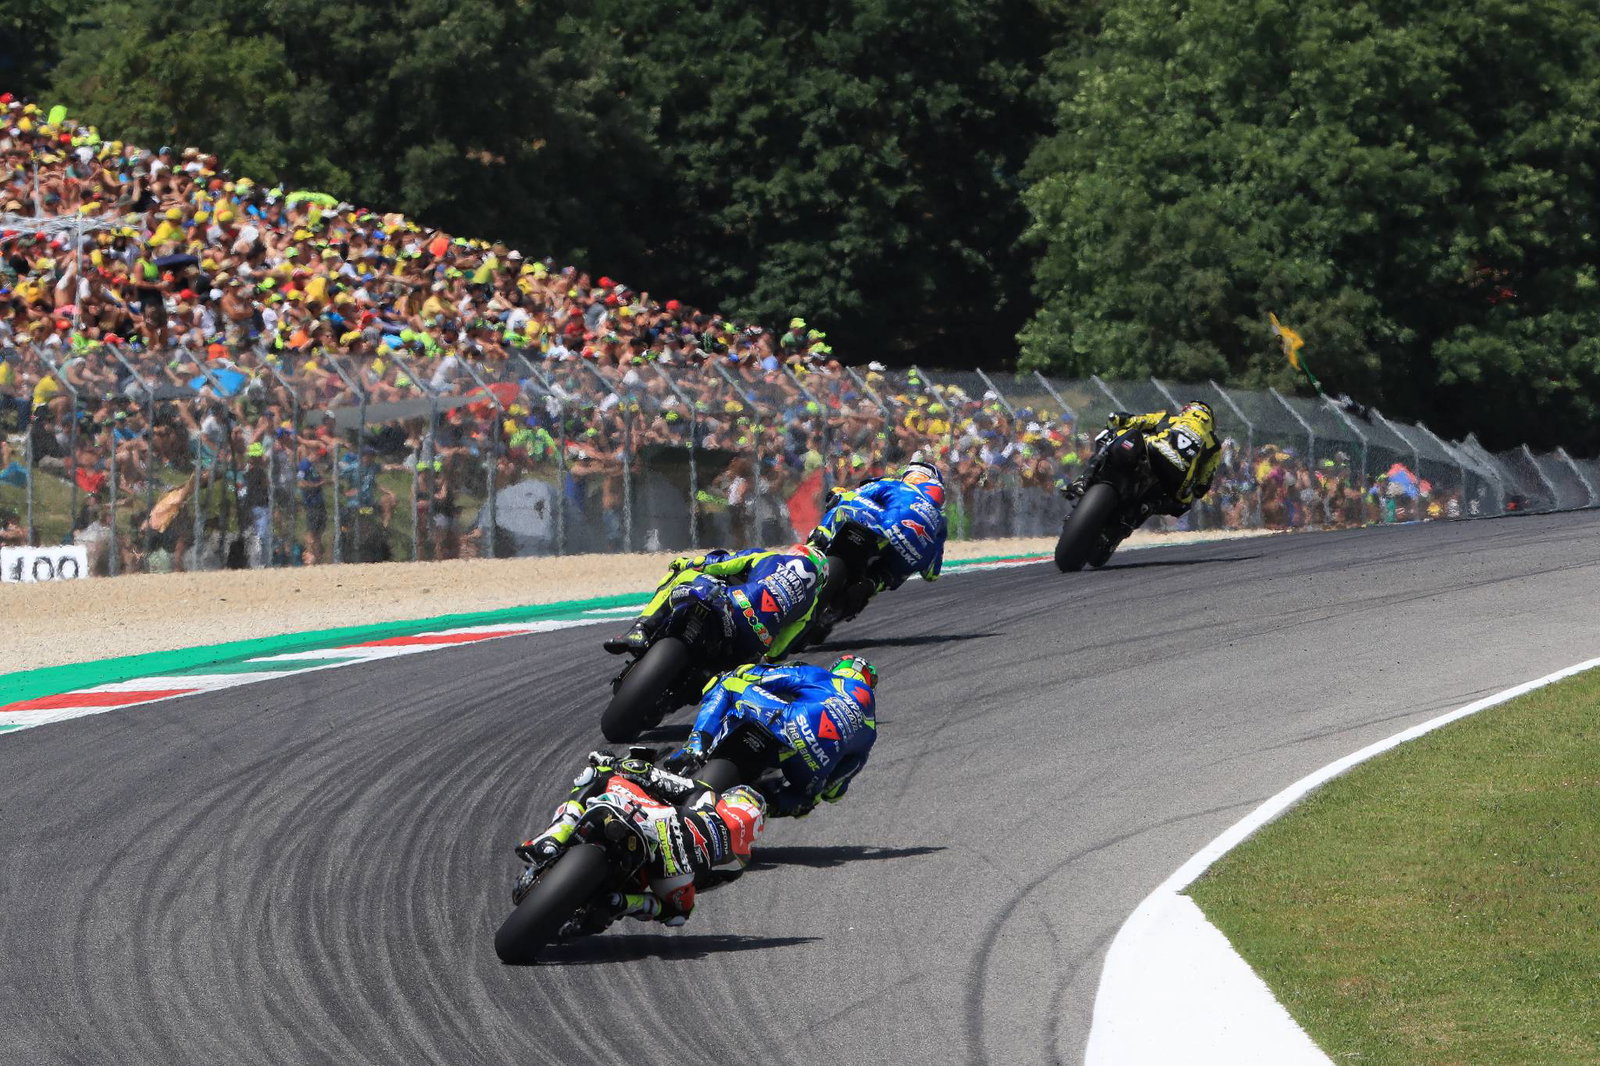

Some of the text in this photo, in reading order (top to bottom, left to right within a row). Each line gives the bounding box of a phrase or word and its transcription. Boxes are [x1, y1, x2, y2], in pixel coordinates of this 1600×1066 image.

[9, 556, 79, 580] 100
[776, 562, 807, 602] YAMAHA
[796, 713, 831, 767] SUZUKI
